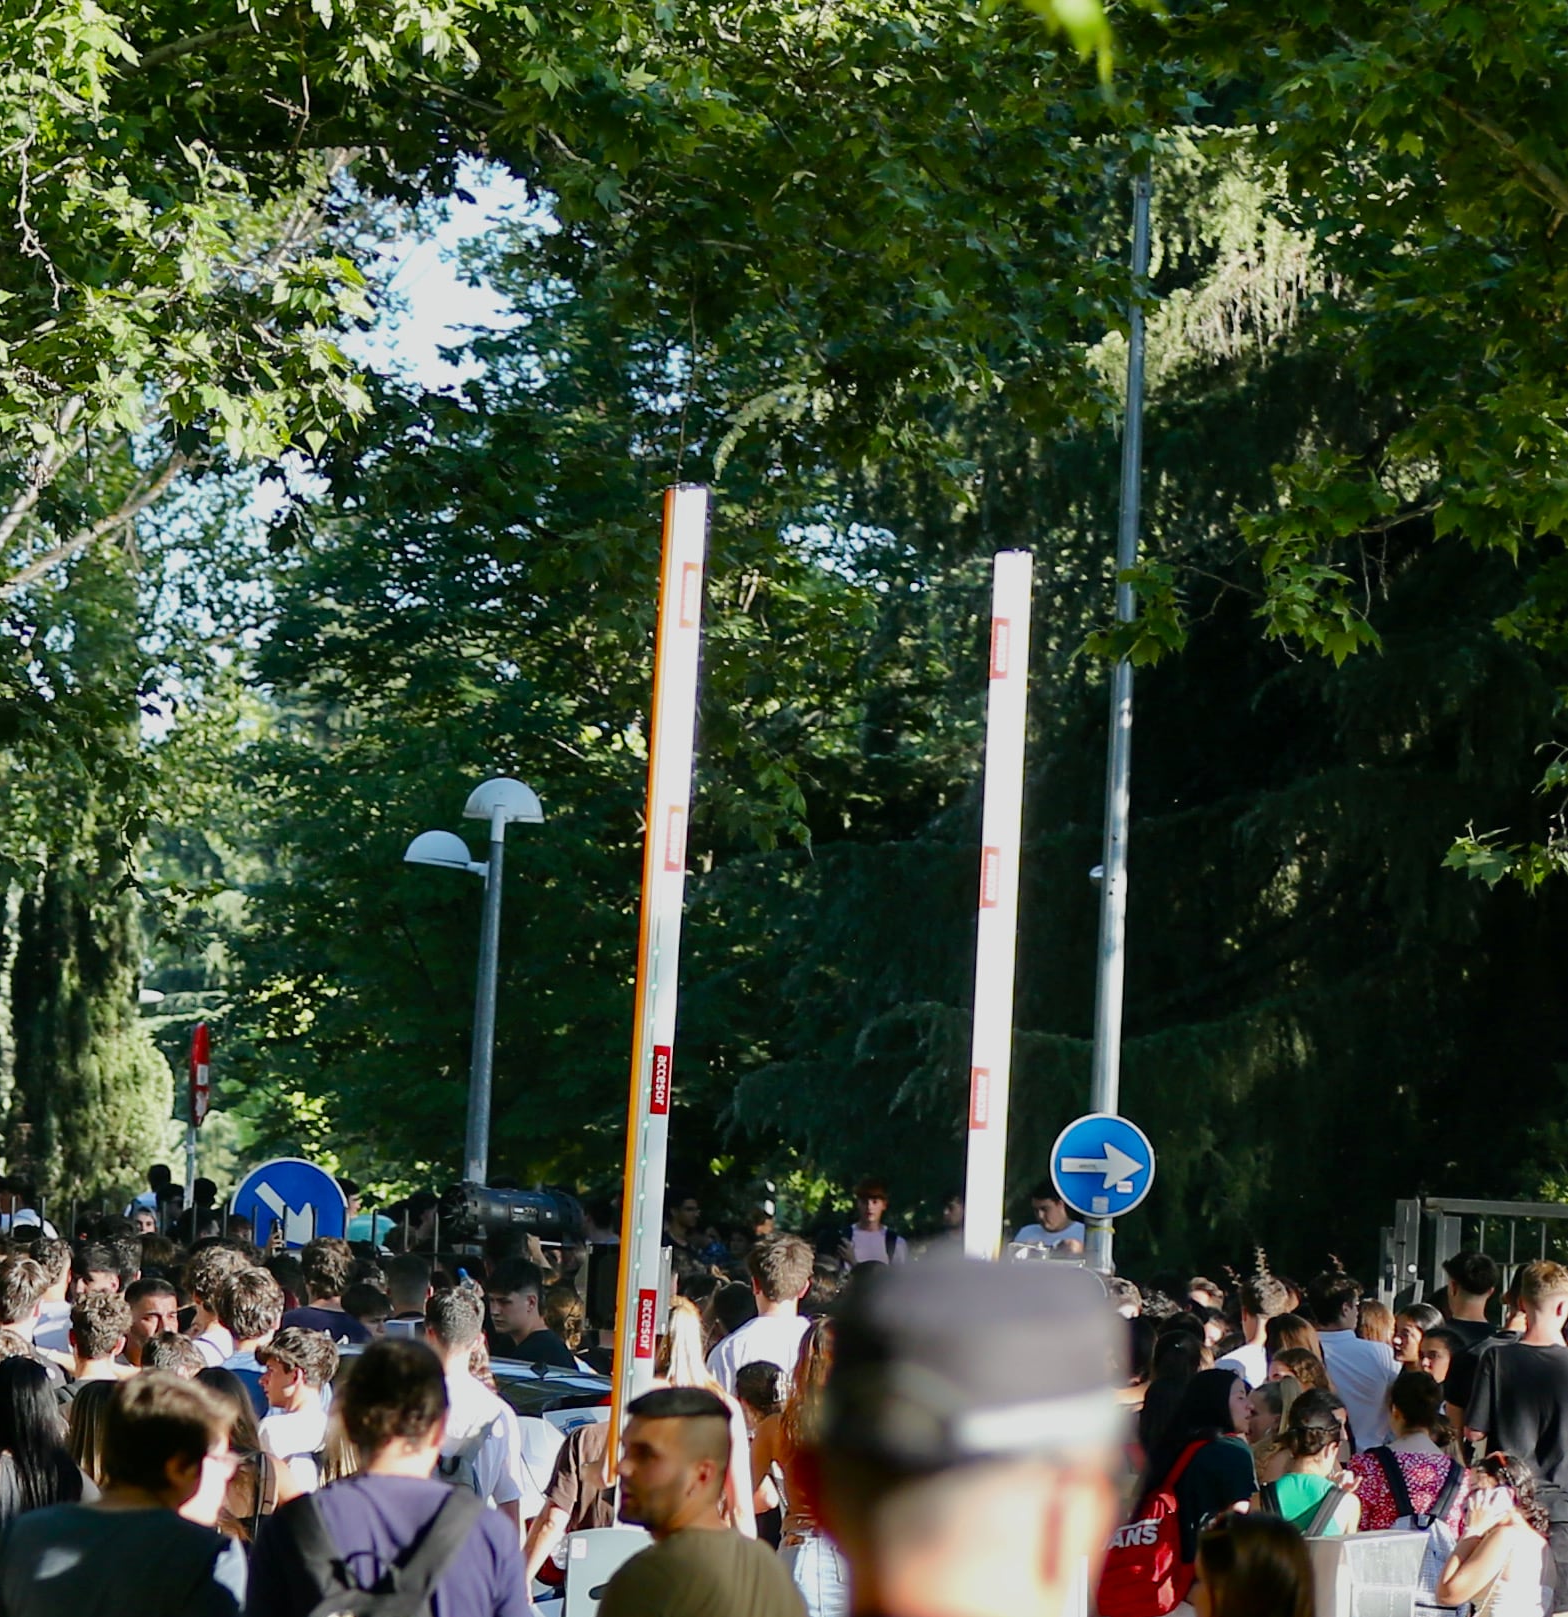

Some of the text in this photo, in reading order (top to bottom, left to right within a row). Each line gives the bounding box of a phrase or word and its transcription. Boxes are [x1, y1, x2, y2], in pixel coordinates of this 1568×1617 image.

[654, 1055, 667, 1106] accesor
[639, 1299, 653, 1350] accesor
[1108, 1518, 1162, 1549] ANS
